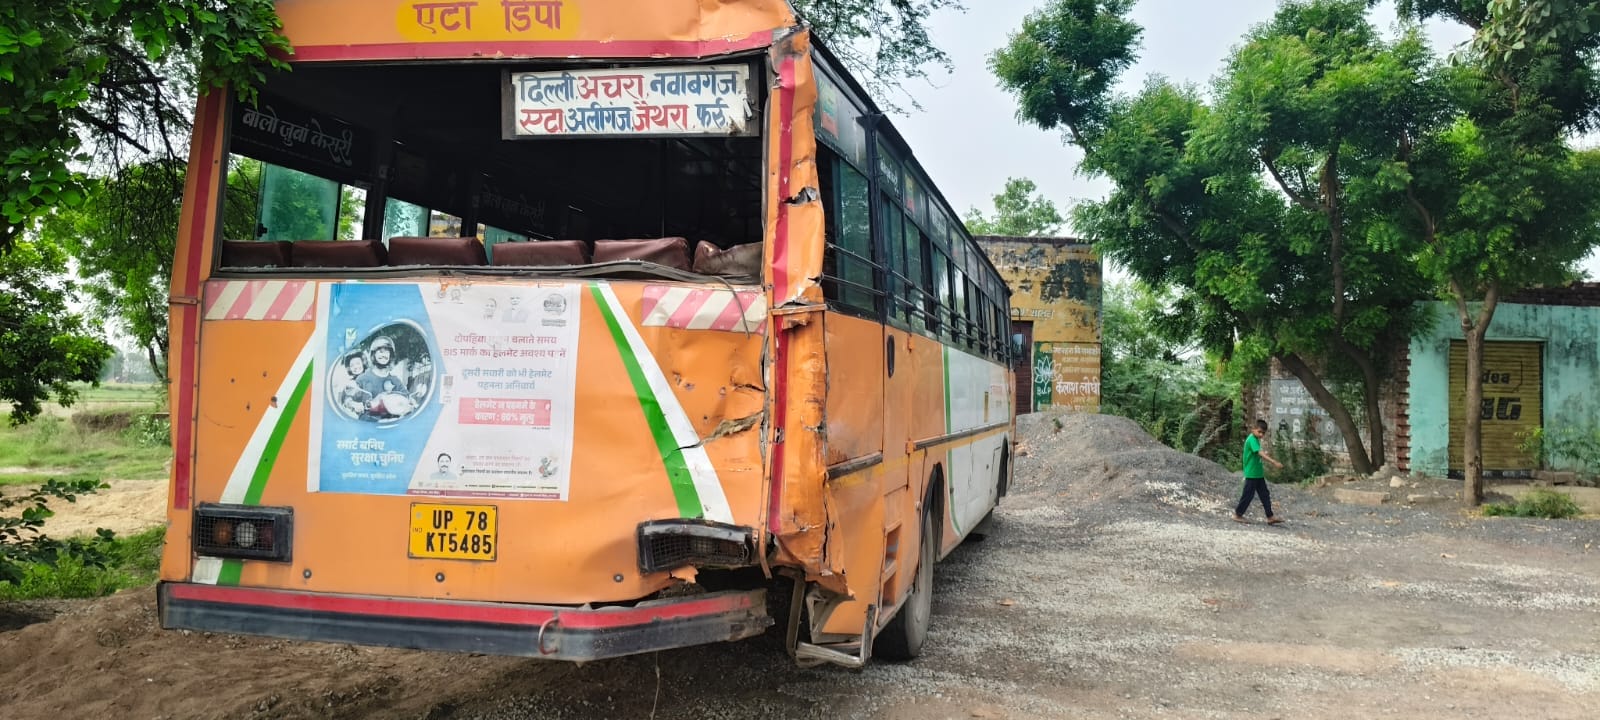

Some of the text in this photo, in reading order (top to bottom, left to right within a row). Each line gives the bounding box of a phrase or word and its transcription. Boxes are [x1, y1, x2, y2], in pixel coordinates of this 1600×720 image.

[412, 1, 478, 34] एटा
[1481, 369, 1510, 385] dea
[433, 510, 487, 531] UP 78
[426, 532, 492, 554] KT5485
